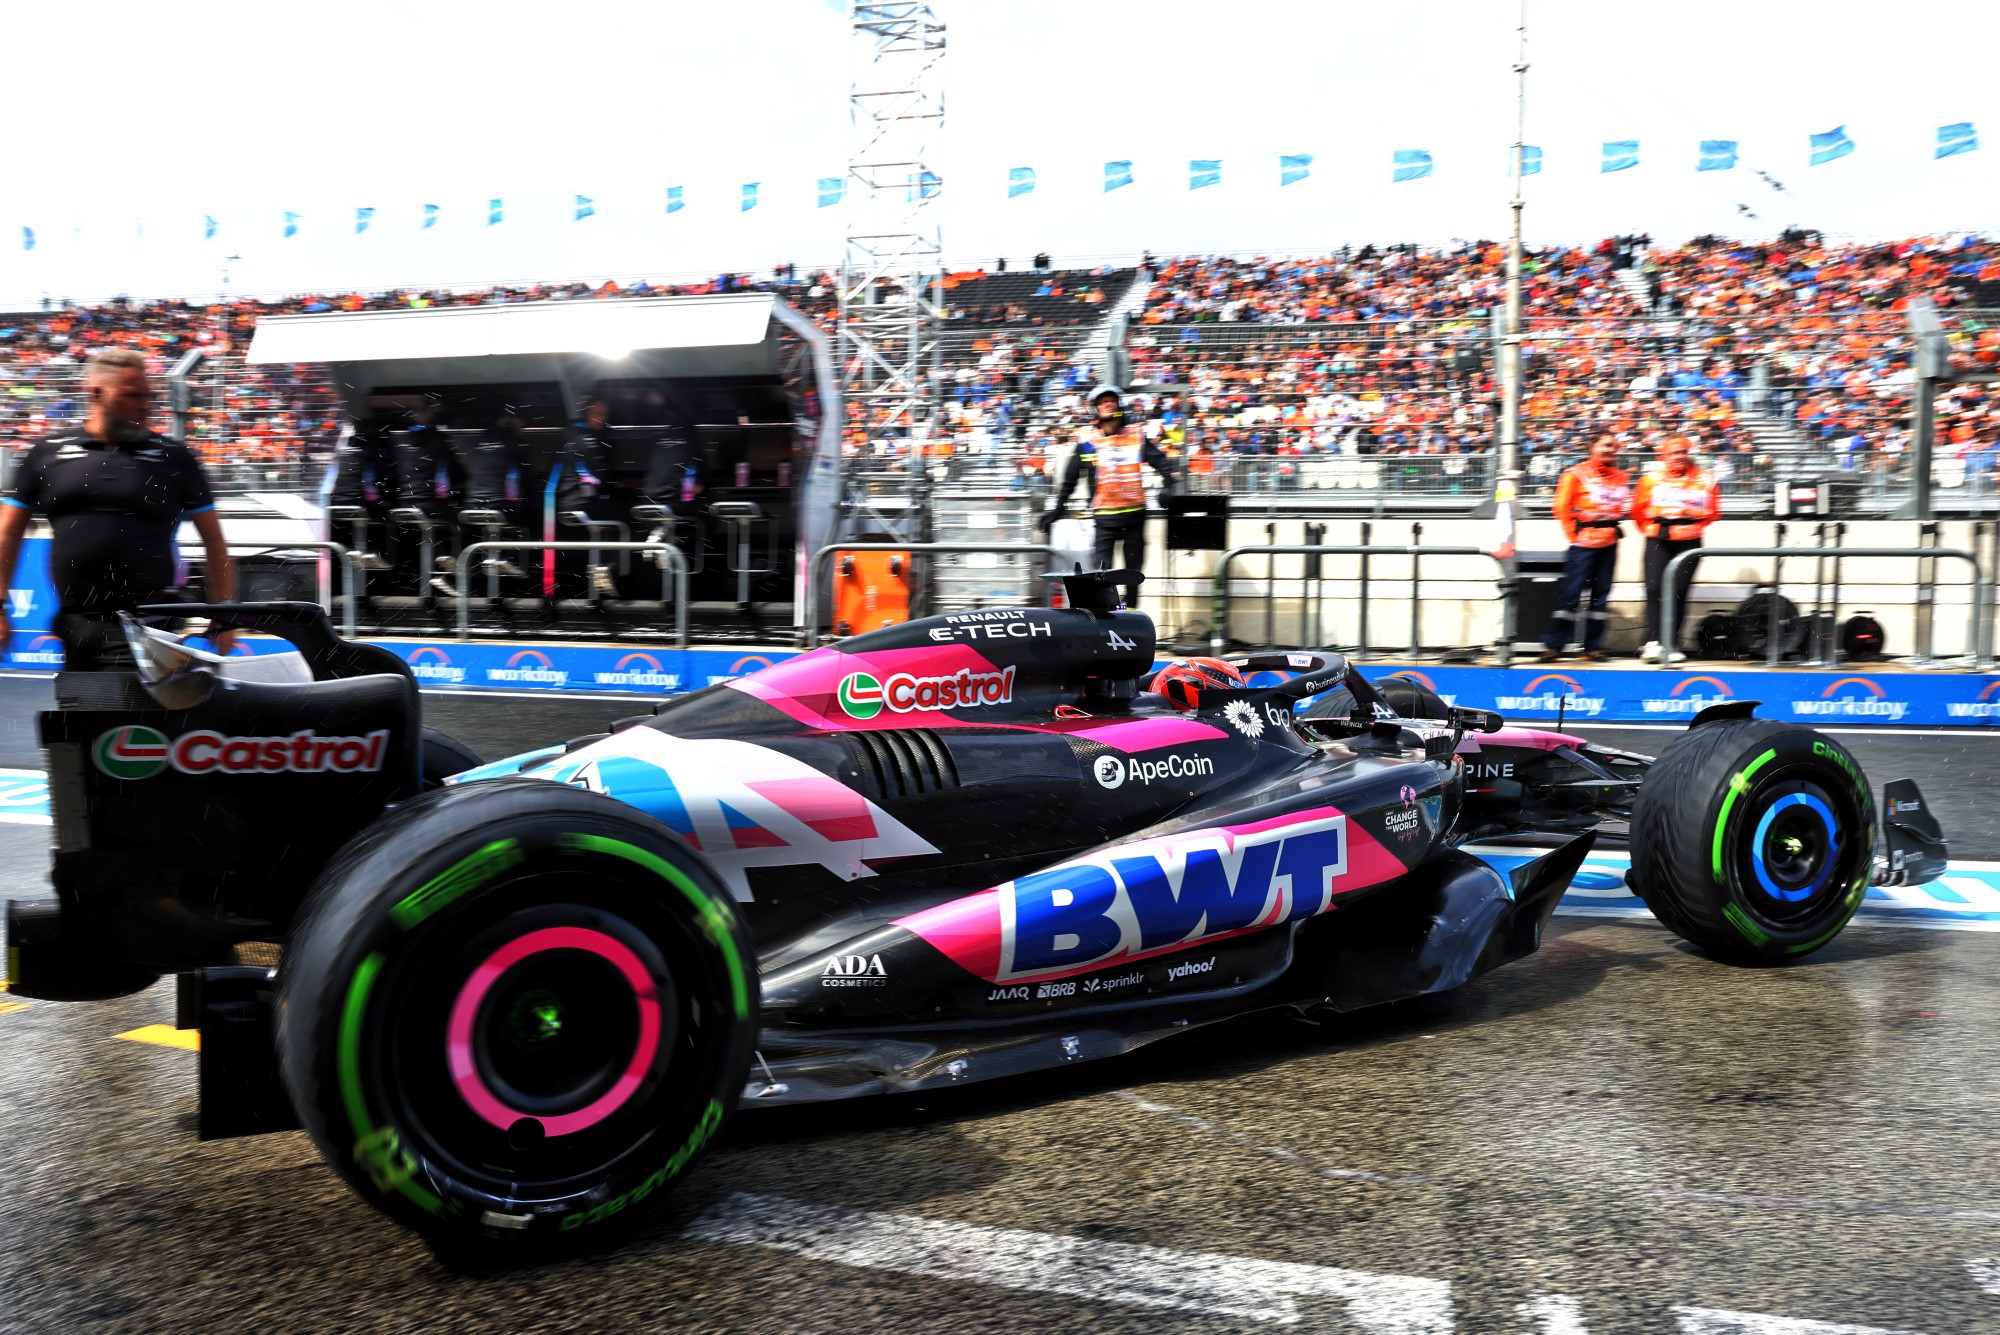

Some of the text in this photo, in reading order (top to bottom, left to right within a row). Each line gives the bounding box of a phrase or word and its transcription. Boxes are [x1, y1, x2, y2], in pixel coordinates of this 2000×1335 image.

[945, 610, 1025, 624] RENAULT
[928, 621, 1052, 642] E-TECH
[884, 666, 1014, 711] Castrol
[1264, 702, 1290, 733] bp
[172, 731, 387, 773] Castrol
[1129, 754, 1214, 786] ApeCoin
[1385, 809, 1417, 826] CHANGE
[1392, 819, 1418, 833] WORLD
[1000, 818, 1346, 979] BWT
[821, 954, 888, 976] ADA
[1168, 956, 1216, 981] yahoo!
[822, 979, 887, 987] COSMETICS
[1050, 982, 1076, 997] BRB
[1102, 972, 1145, 991] sprinklr
